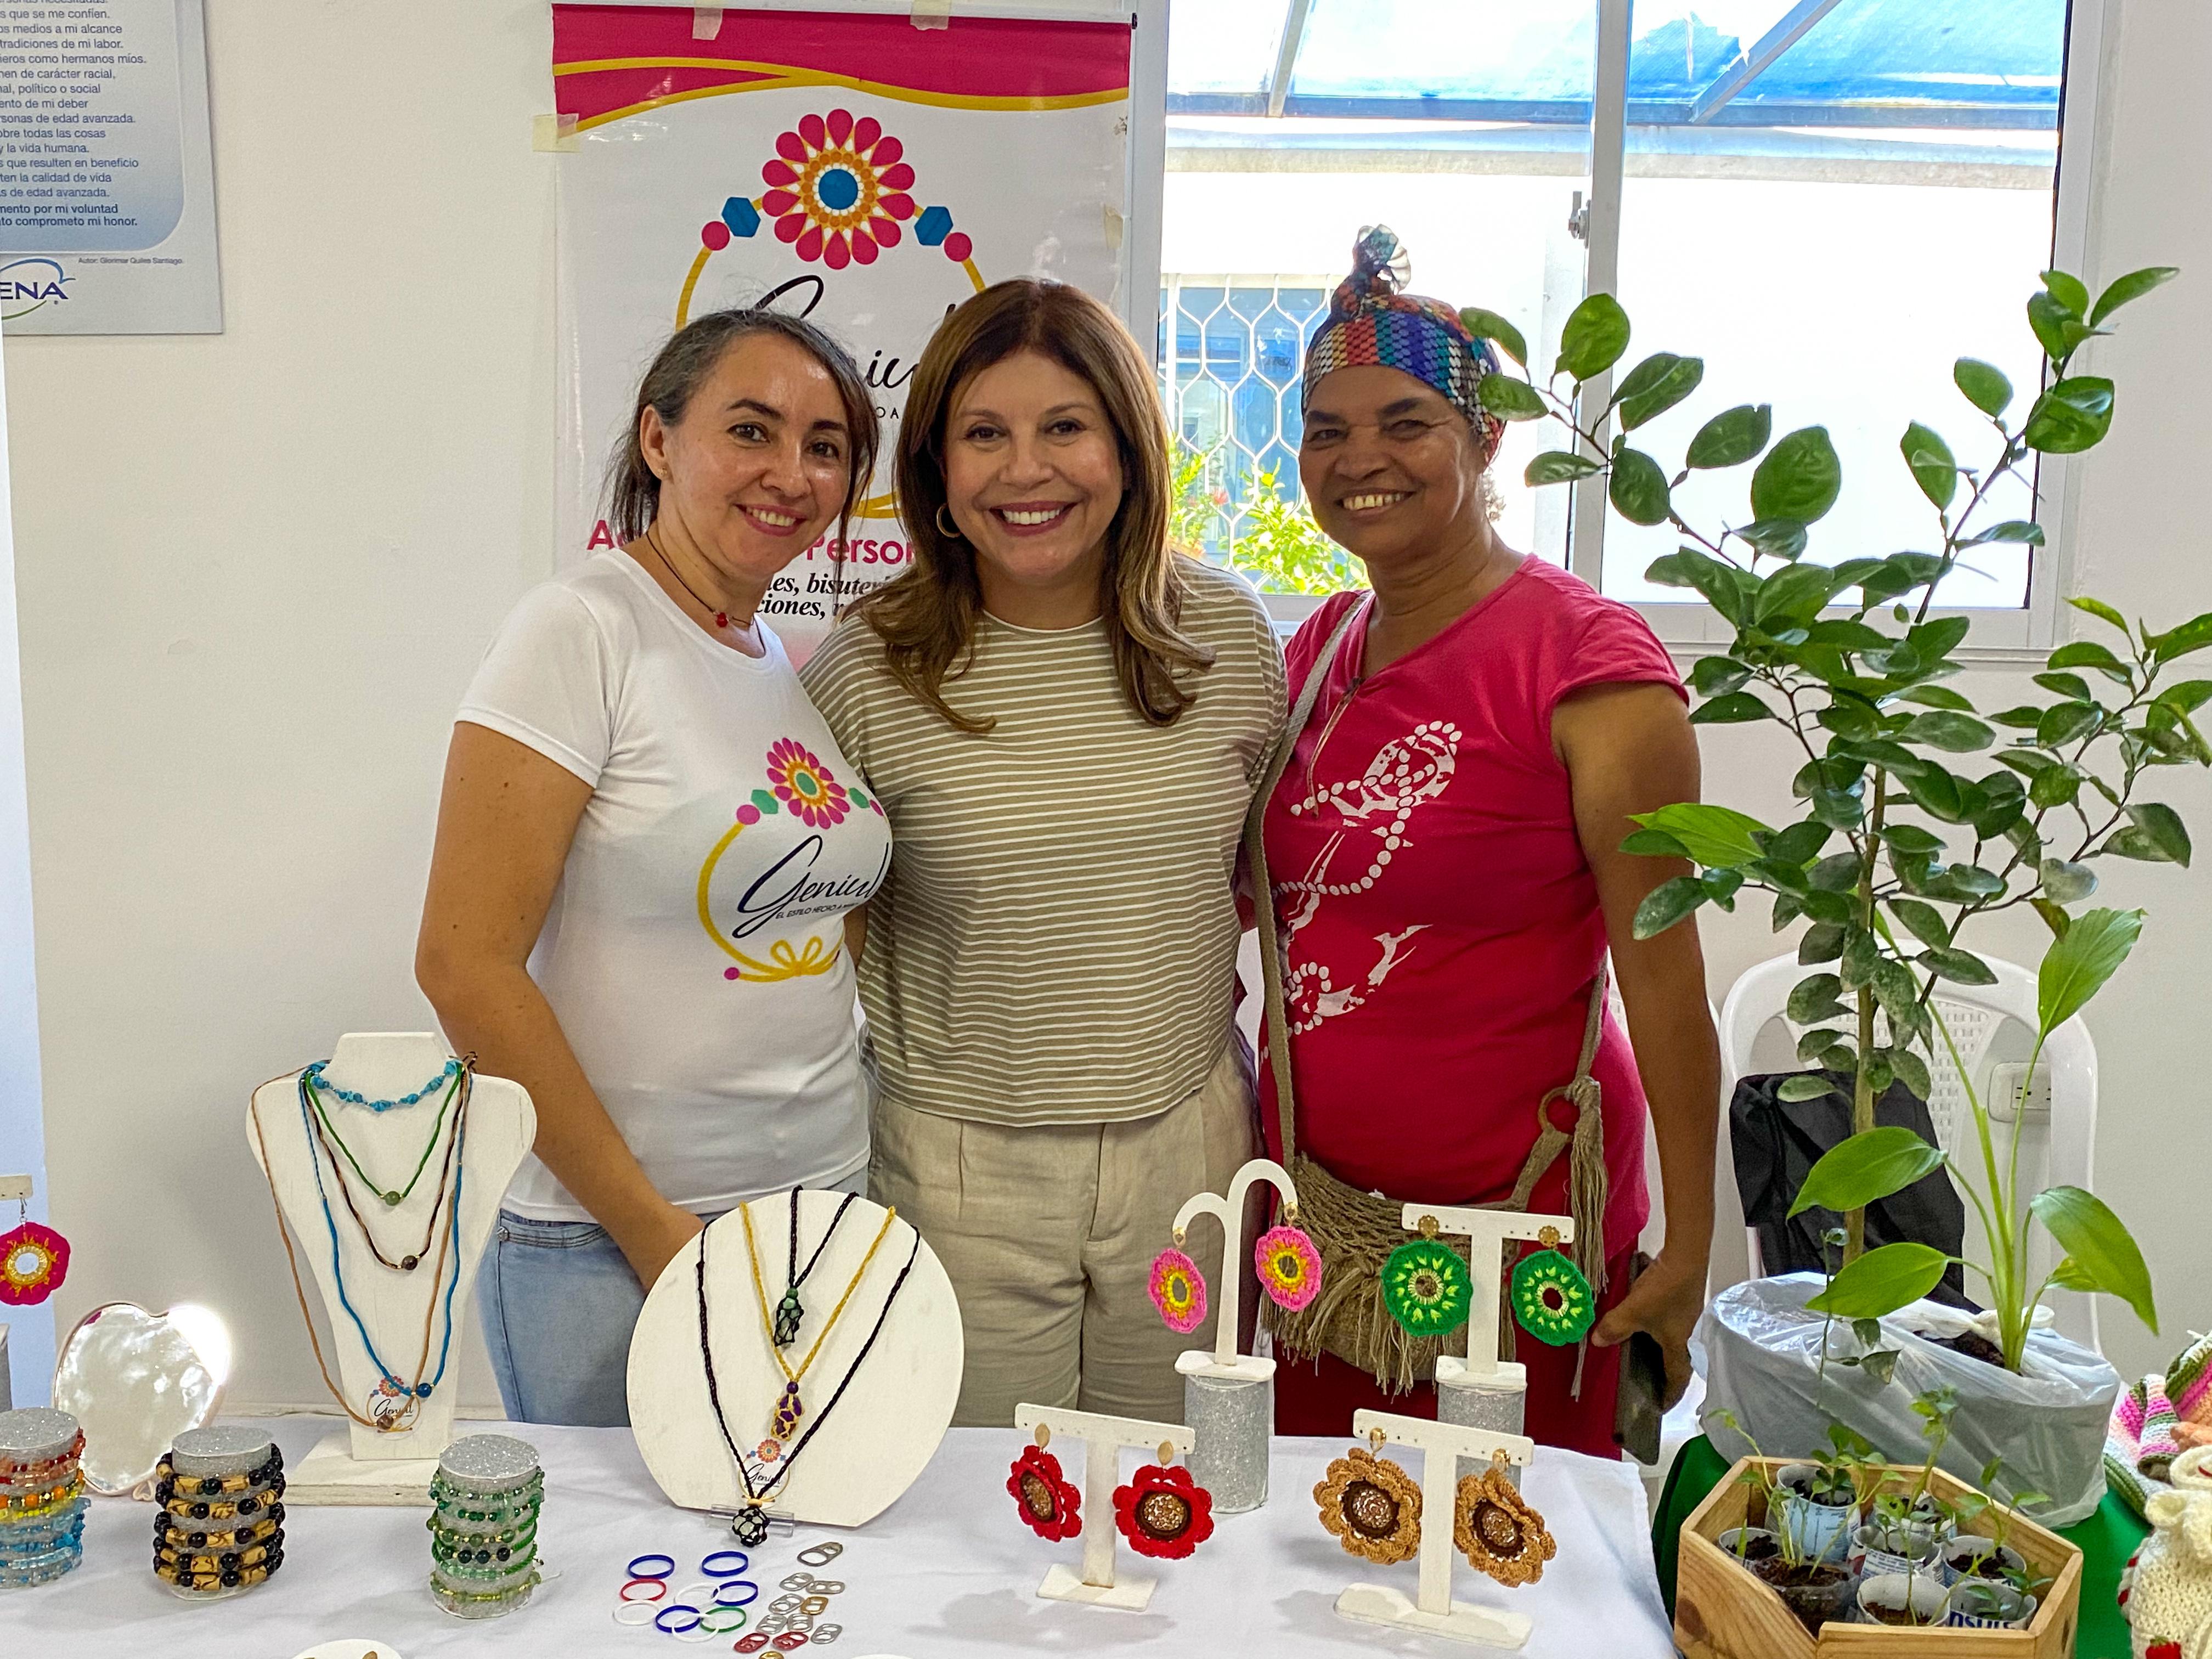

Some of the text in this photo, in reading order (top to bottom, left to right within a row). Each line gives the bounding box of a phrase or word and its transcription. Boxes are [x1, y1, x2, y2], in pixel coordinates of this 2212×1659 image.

[9, 11, 29, 21] que
[13, 24, 52, 33] medios
[65, 24, 77, 33] mi
[81, 24, 122, 33] alcance
[0, 39, 123, 48] tradiciones de mi labor.
[62, 53, 114, 63] hermanos
[118, 53, 146, 63] míos.
[21, 69, 34, 78] de
[37, 68, 80, 78] carácter
[84, 69, 116, 79] racial,
[70, 84, 100, 93] social
[25, 99, 38, 108] de
[42, 99, 54, 108] mi
[58, 98, 88, 108] deber
[36, 114, 49, 123] de
[53, 114, 79, 123] edad
[82, 114, 136, 123] avanzada.
[24, 129, 53, 137] todas
[57, 129, 71, 137] las
[7, 143, 16, 153] la
[19, 143, 41, 153] vida
[44, 144, 89, 153] humana.
[7, 160, 27, 170] que
[30, 158, 71, 167] resulten
[91, 158, 139, 167] beneficio
[20, 173, 29, 182] la
[32, 173, 70, 182] calidad
[74, 173, 87, 182] de
[89, 173, 112, 182] vida
[10, 188, 23, 197] de
[26, 188, 53, 197] edad
[56, 188, 110, 197] avanzada.
[34, 206, 52, 215] por
[55, 205, 68, 213] mi
[71, 204, 118, 213] voluntad
[15, 218, 84, 228] comprometo
[88, 217, 100, 226] mi
[104, 217, 137, 226] honor.
[786, 907, 811, 917] ESTILO
[812, 904, 834, 913] HECHO
